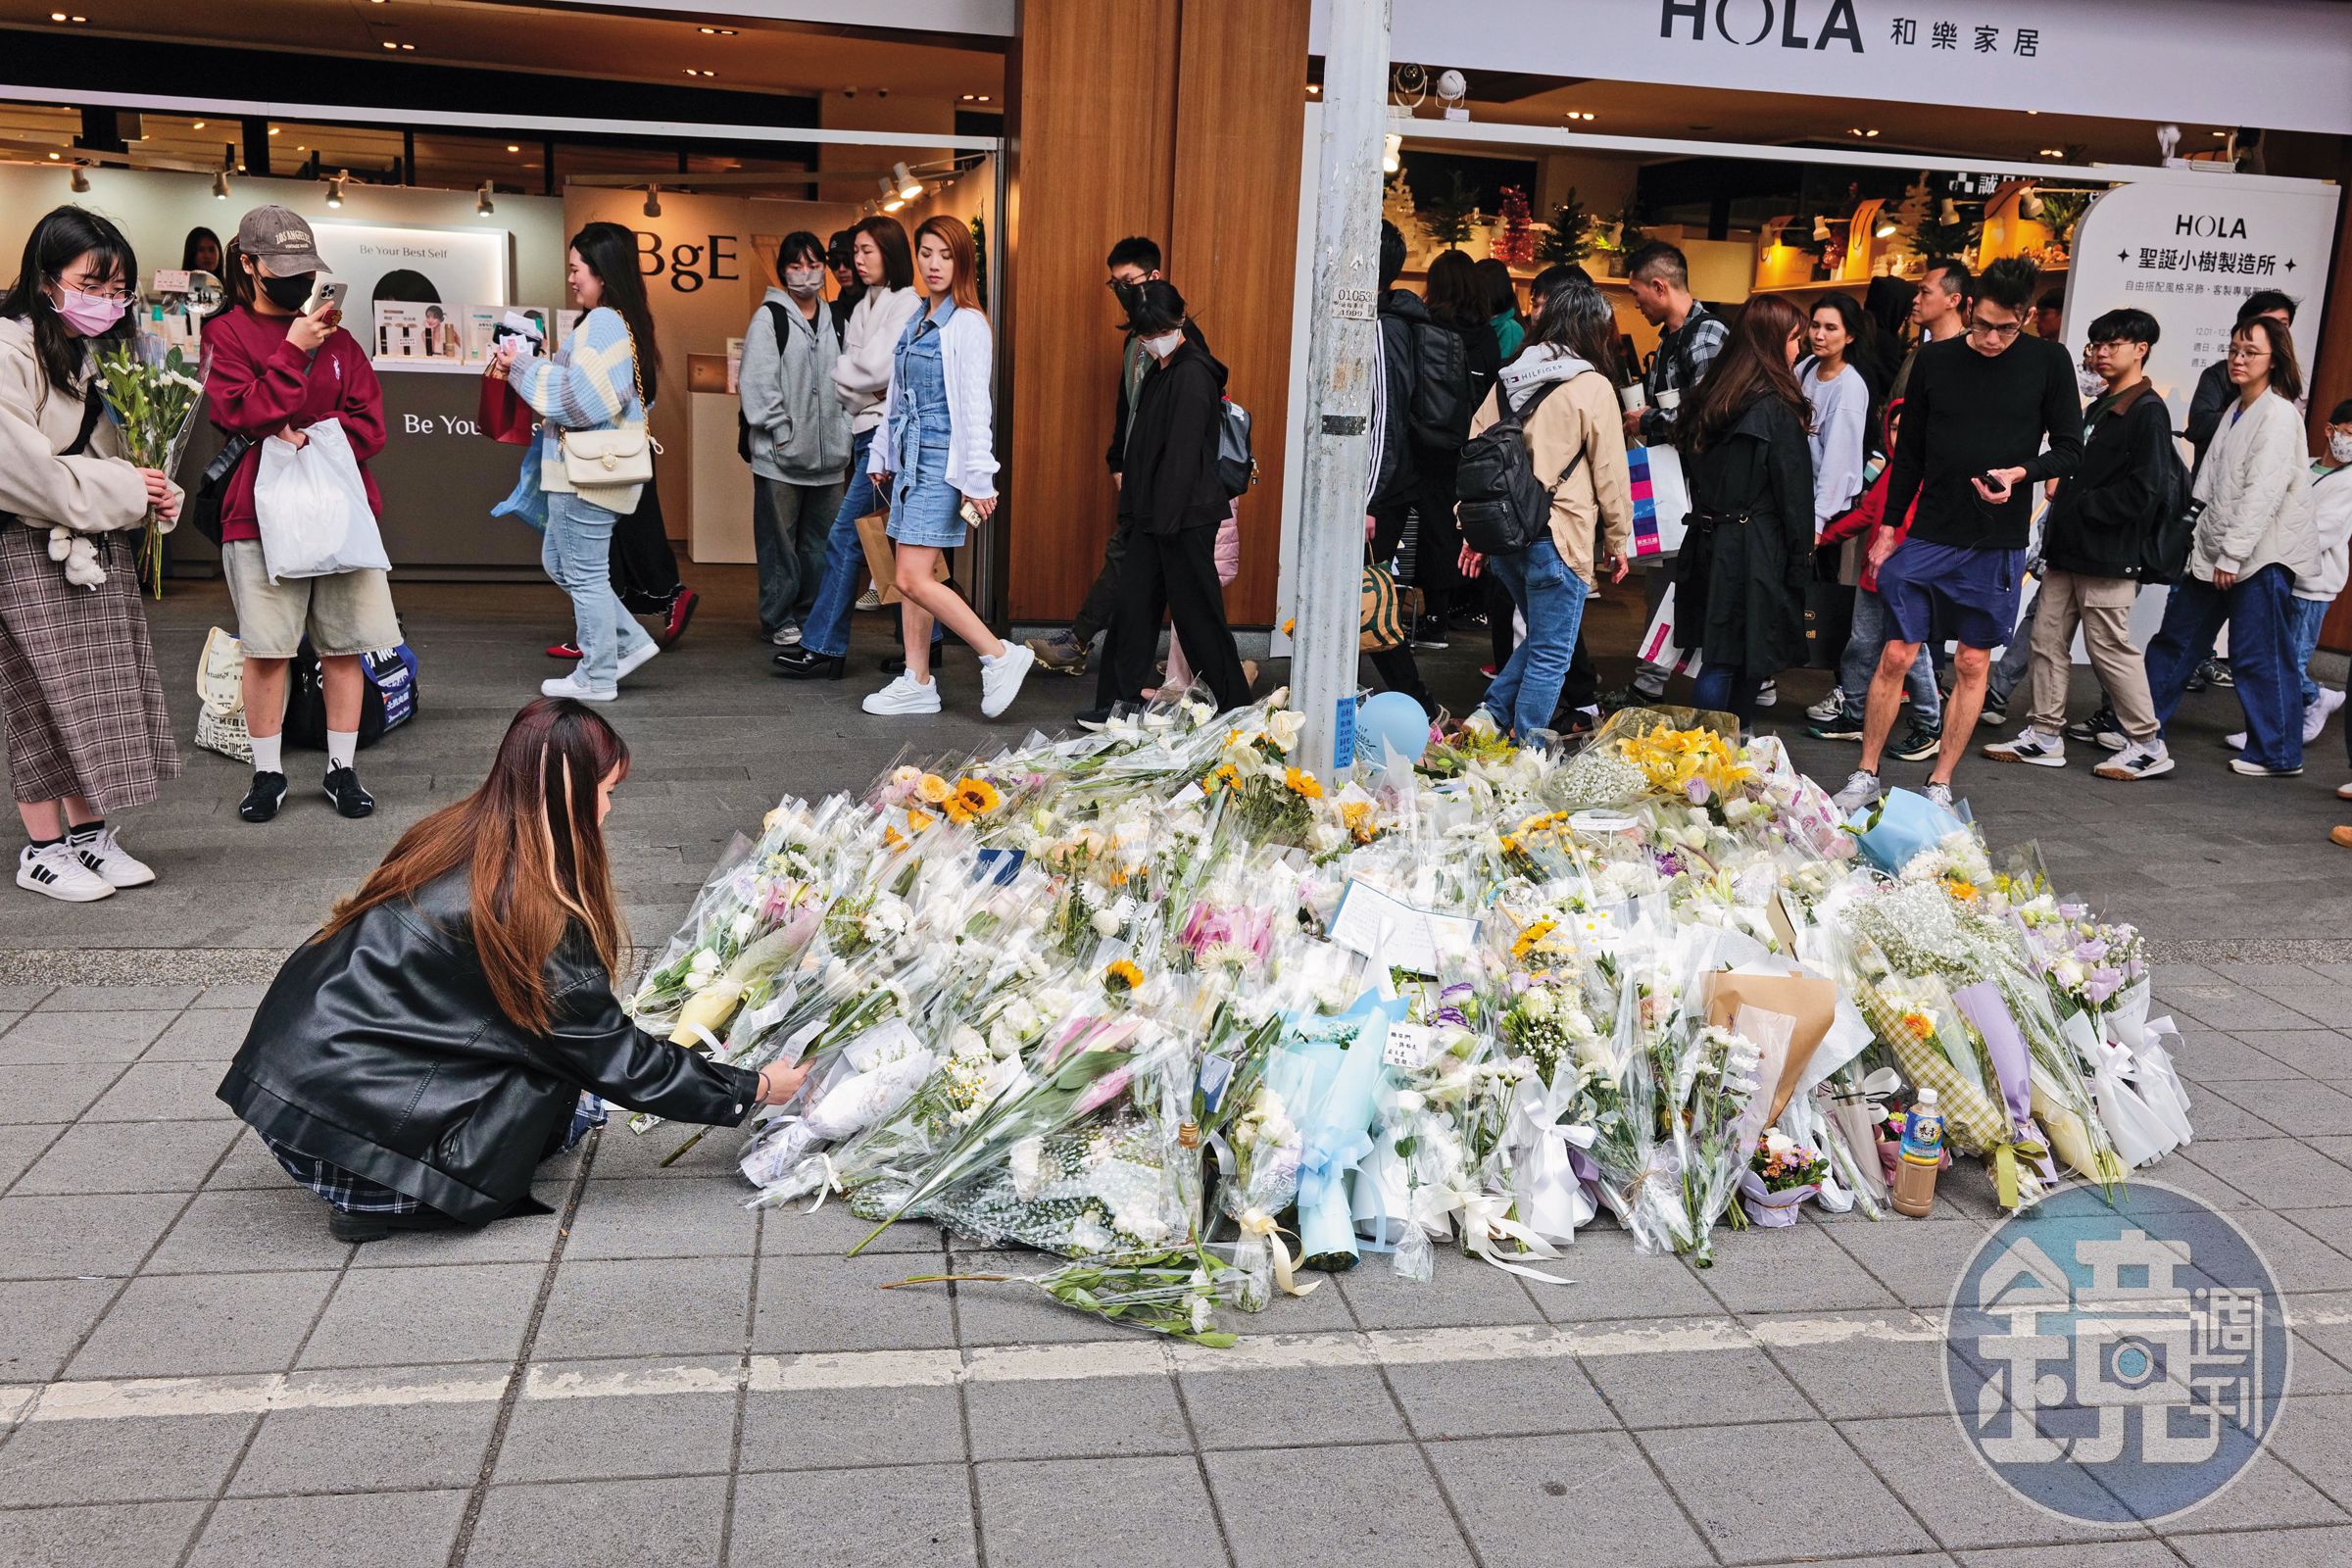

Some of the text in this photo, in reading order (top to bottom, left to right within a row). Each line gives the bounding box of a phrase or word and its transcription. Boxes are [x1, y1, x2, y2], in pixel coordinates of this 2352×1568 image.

[1660, 0, 1864, 53] HOLA
[1890, 17, 2039, 57] 和樂家居
[2176, 214, 2247, 239] HOLA
[360, 244, 448, 259] Be Your Best Self
[2138, 247, 2276, 275] 聖誕小樹製造所
[1521, 364, 1563, 381] HILFIGER
[403, 414, 482, 435] Be You
